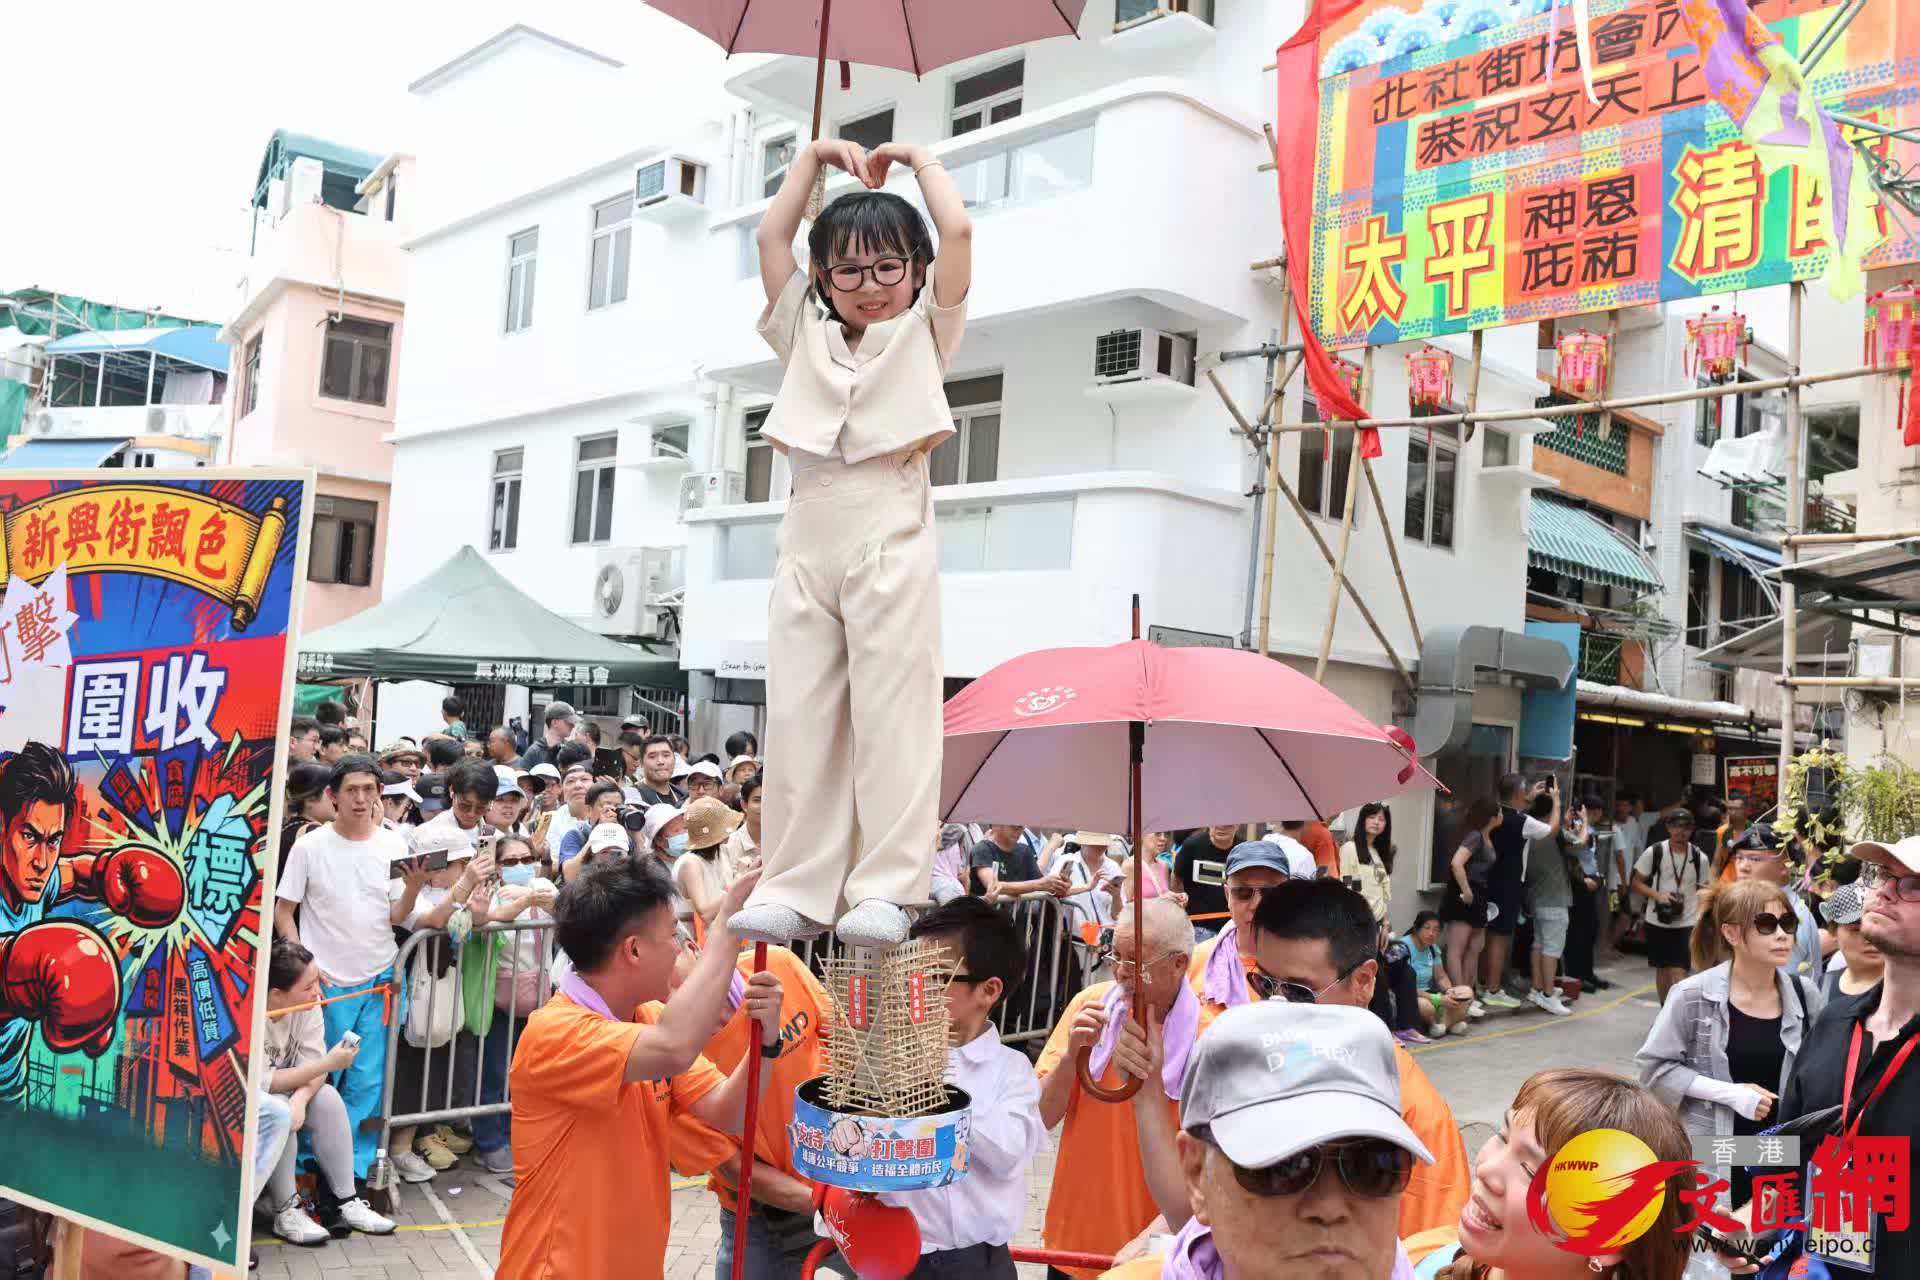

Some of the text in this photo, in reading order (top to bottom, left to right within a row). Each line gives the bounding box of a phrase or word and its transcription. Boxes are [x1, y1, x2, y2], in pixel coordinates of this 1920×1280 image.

[1524, 174, 1639, 238] 神恩
[1343, 193, 1495, 332] 太平
[23, 497, 228, 580] 新興街飄色
[67, 651, 226, 755] 圍收
[187, 830, 243, 914] 標
[174, 977, 190, 1057] 黑箱作業
[190, 960, 220, 1042] 高價低質
[779, 1011, 808, 1041] WD
